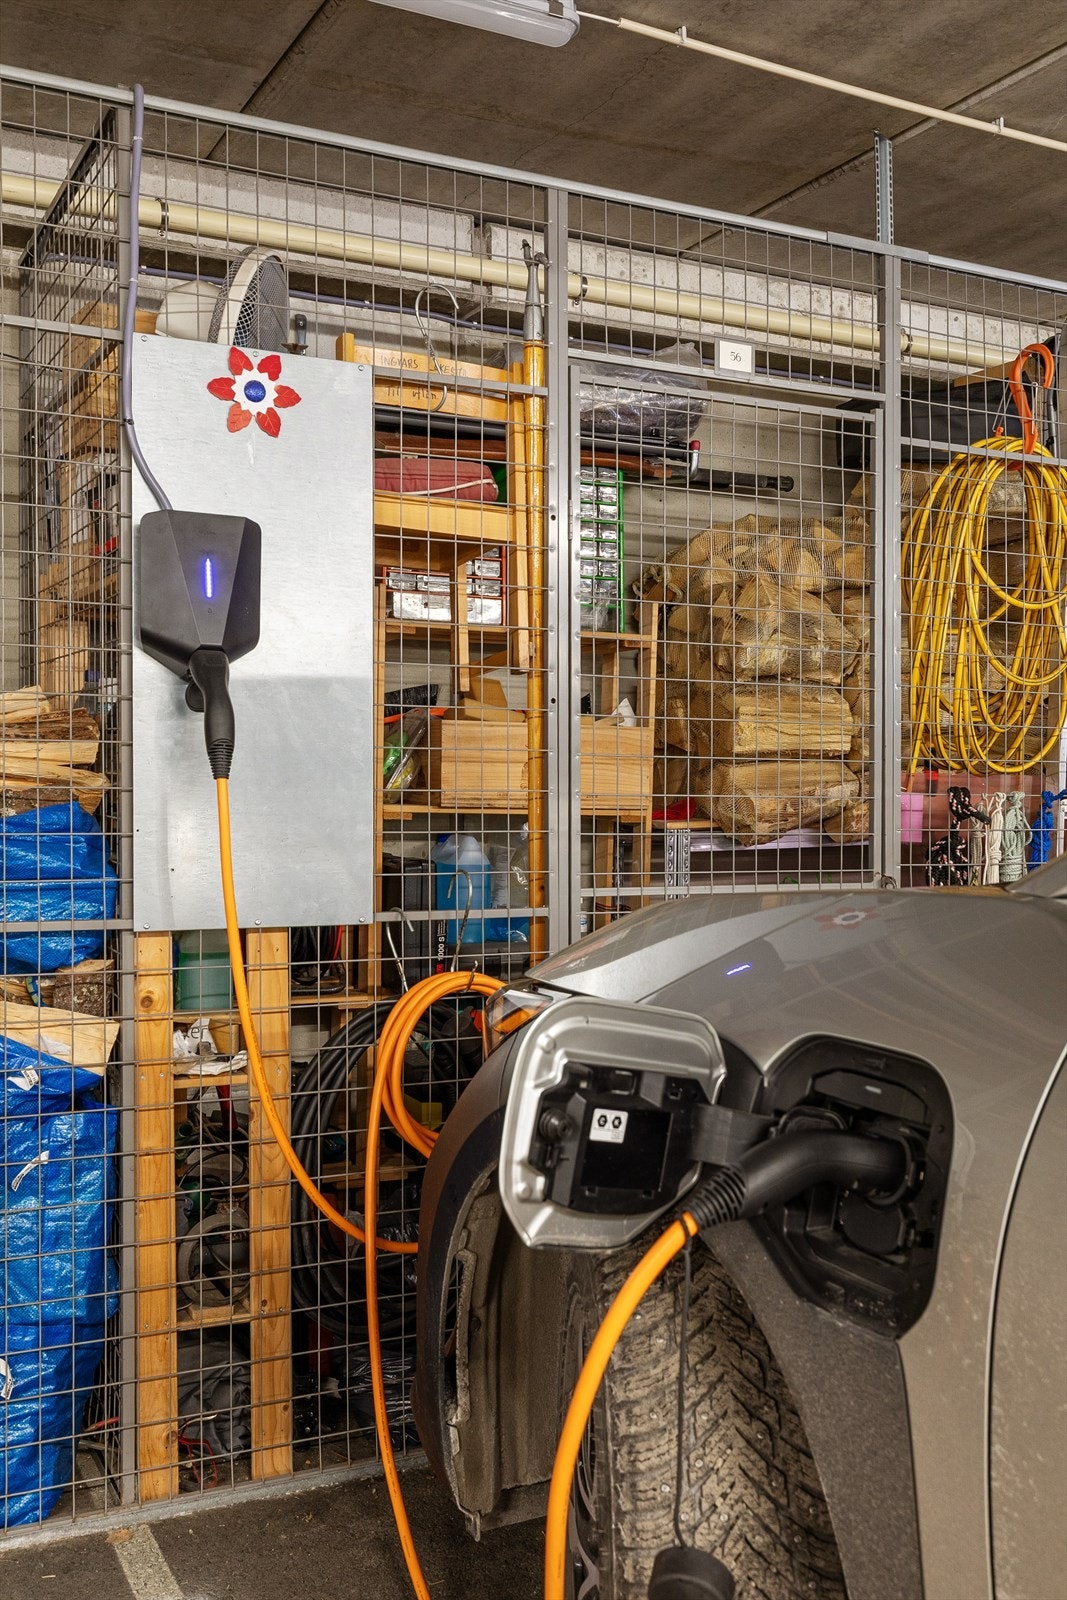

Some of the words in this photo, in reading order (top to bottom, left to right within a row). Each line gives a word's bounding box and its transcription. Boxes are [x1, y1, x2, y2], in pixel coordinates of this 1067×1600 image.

[380, 355, 419, 369] INGVARS
[730, 351, 742, 363] 56
[437, 943, 446, 961] 1000
